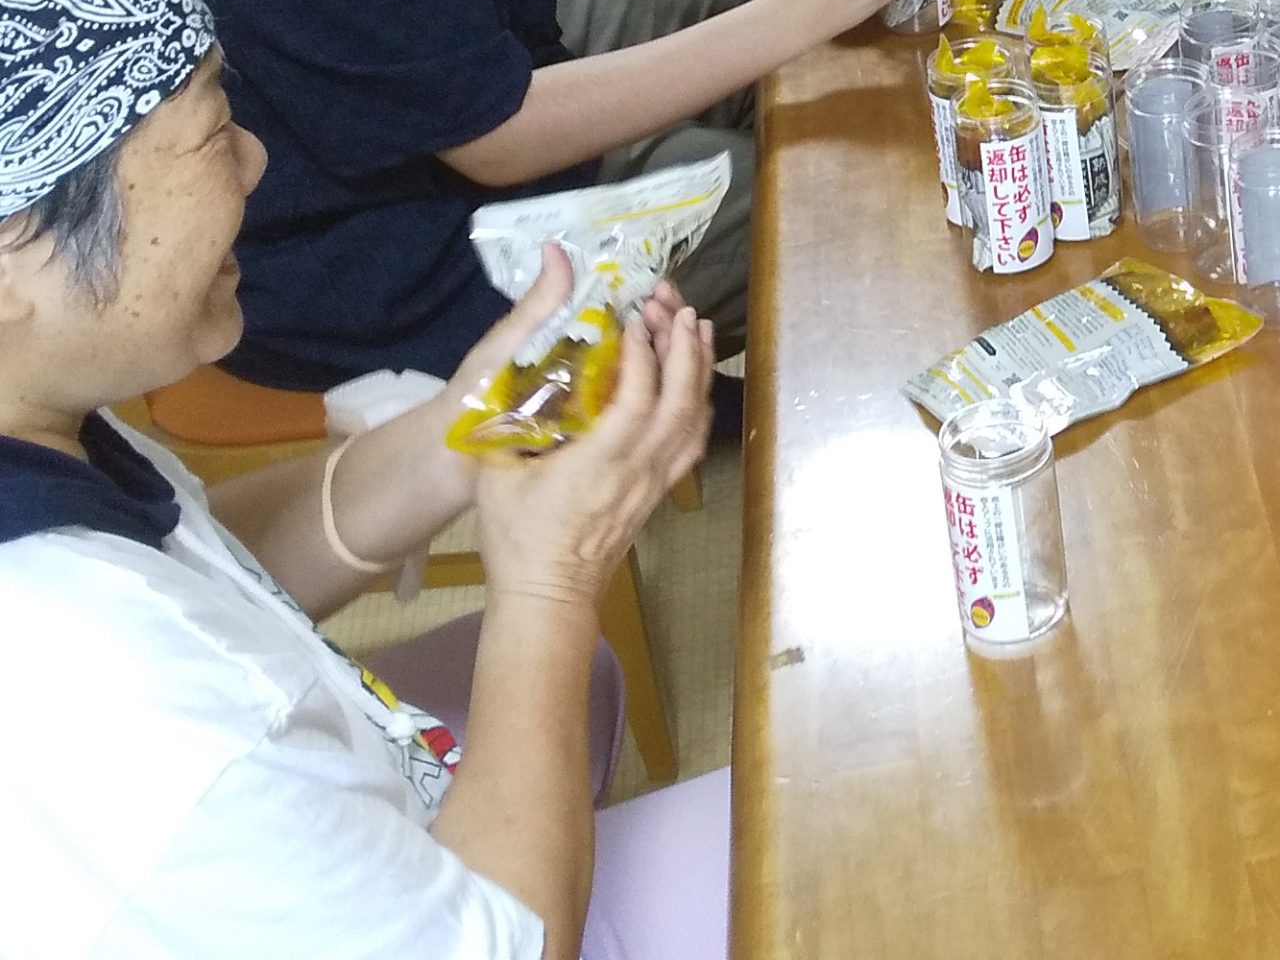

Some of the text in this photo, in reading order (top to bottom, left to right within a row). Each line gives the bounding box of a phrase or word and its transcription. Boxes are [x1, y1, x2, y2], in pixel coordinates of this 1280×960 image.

[987, 148, 1016, 266] 返却して下さい
[1010, 144, 1031, 225] 缶は必ず
[955, 492, 984, 585] 缶は必ず
